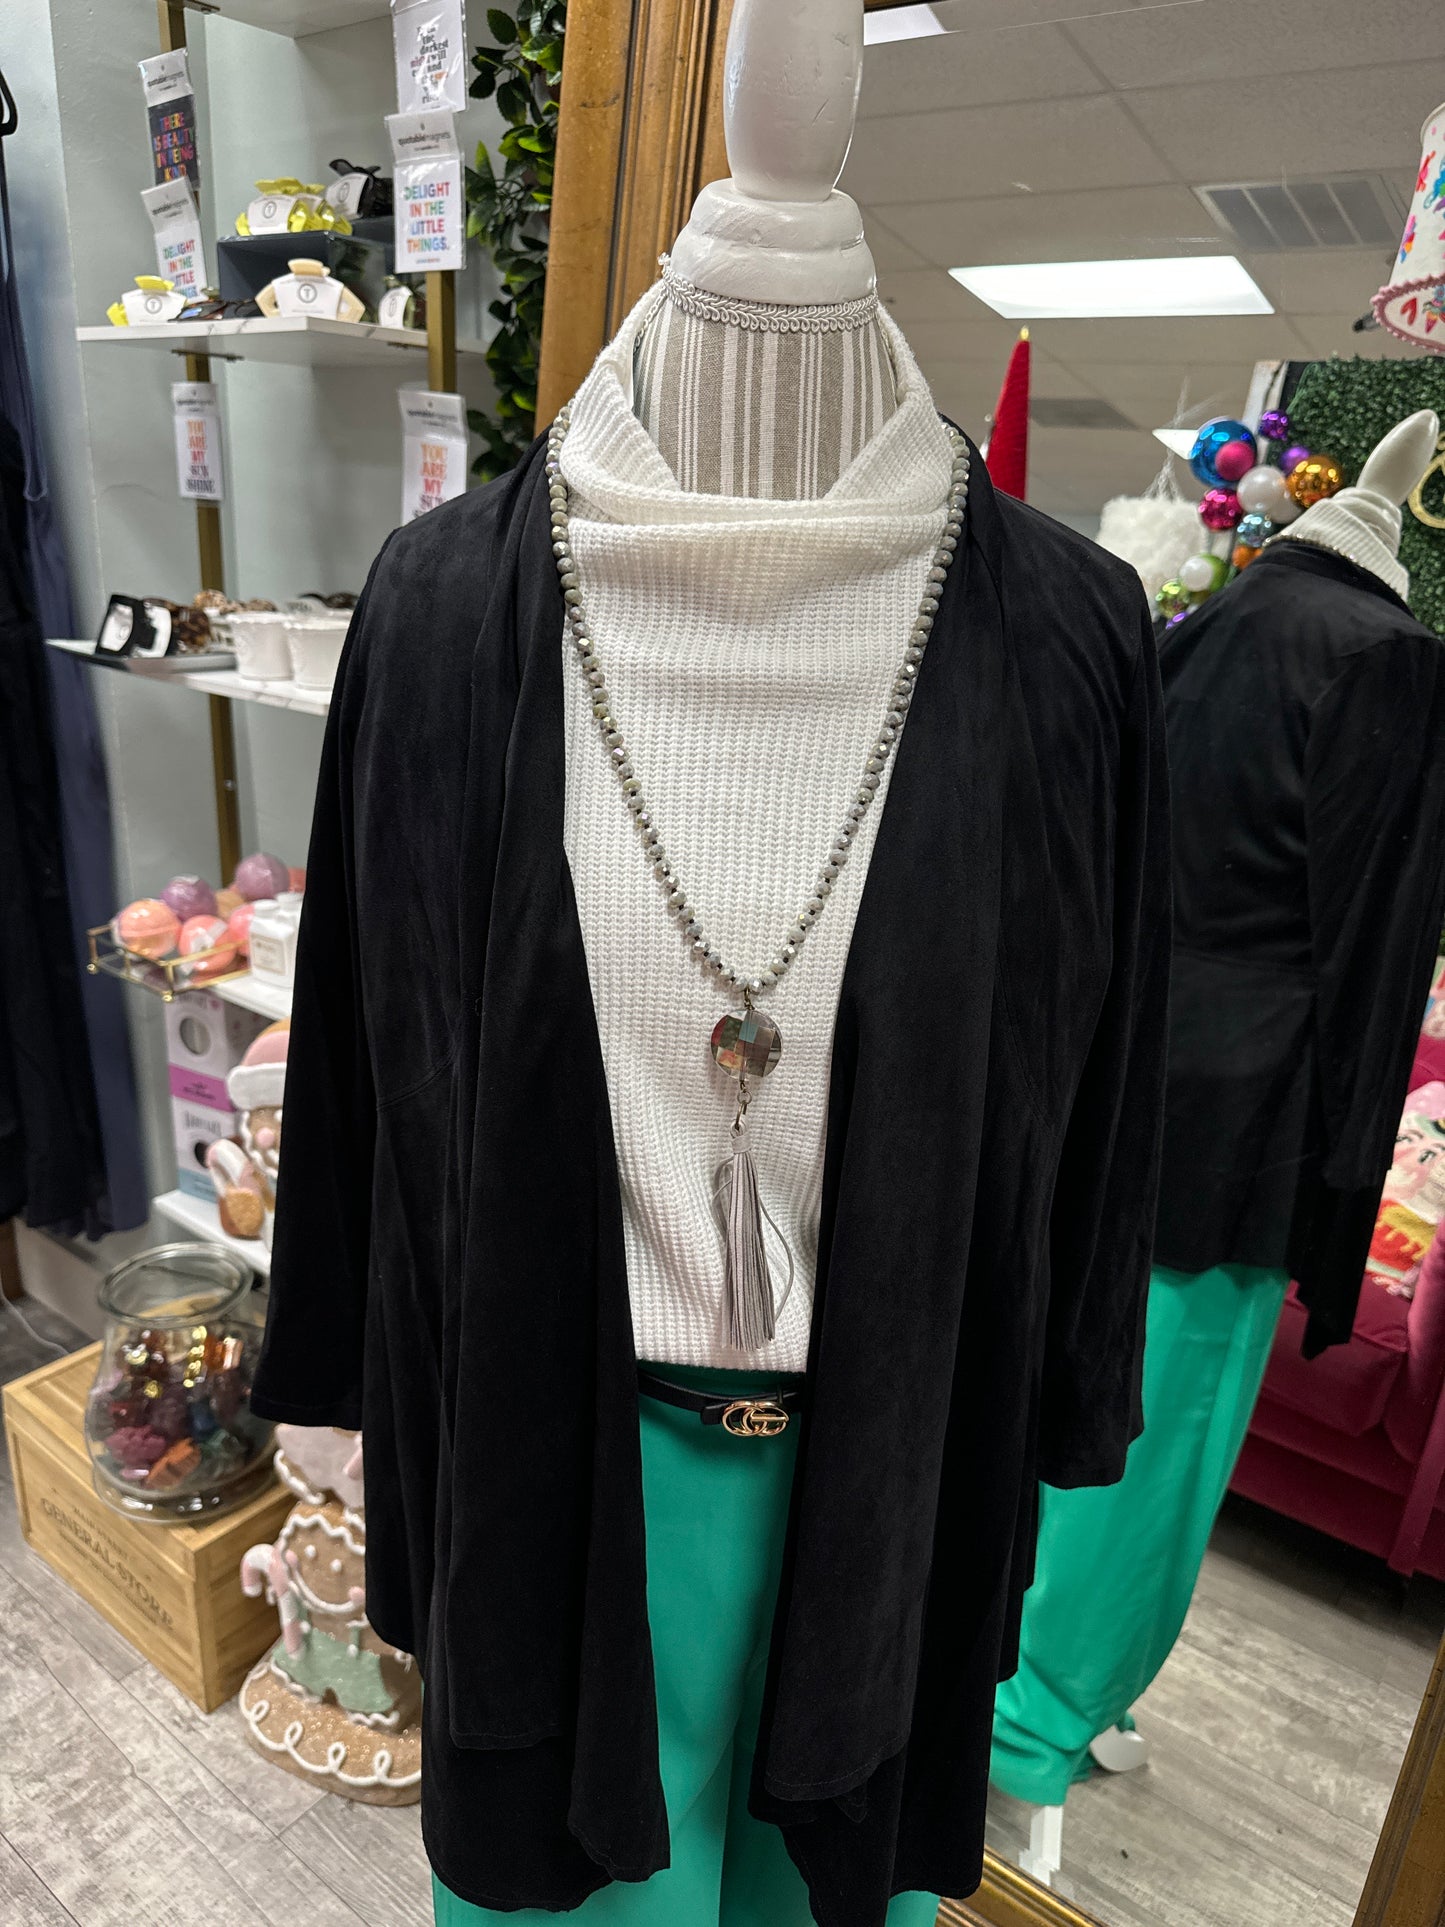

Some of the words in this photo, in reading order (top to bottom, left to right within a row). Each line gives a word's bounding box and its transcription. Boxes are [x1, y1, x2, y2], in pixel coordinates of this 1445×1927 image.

[420, 39, 449, 56] darkest
[160, 112, 185, 131] THERE
[162, 127, 195, 150] BEAUTY
[167, 143, 194, 165] BEING
[404, 182, 451, 200] DELIGHT
[410, 203, 422, 217] IN
[424, 201, 445, 216] THE
[411, 219, 445, 235] LITTLE
[163, 239, 196, 260] DELIGHT
[168, 260, 177, 273] IN
[178, 255, 193, 270] THE
[421, 443, 448, 460] YOU
[420, 462, 447, 479] ARE
[424, 478, 444, 494] MY
[40, 1498, 116, 1570] GENERAL
[115, 1561, 174, 1631] STORE
